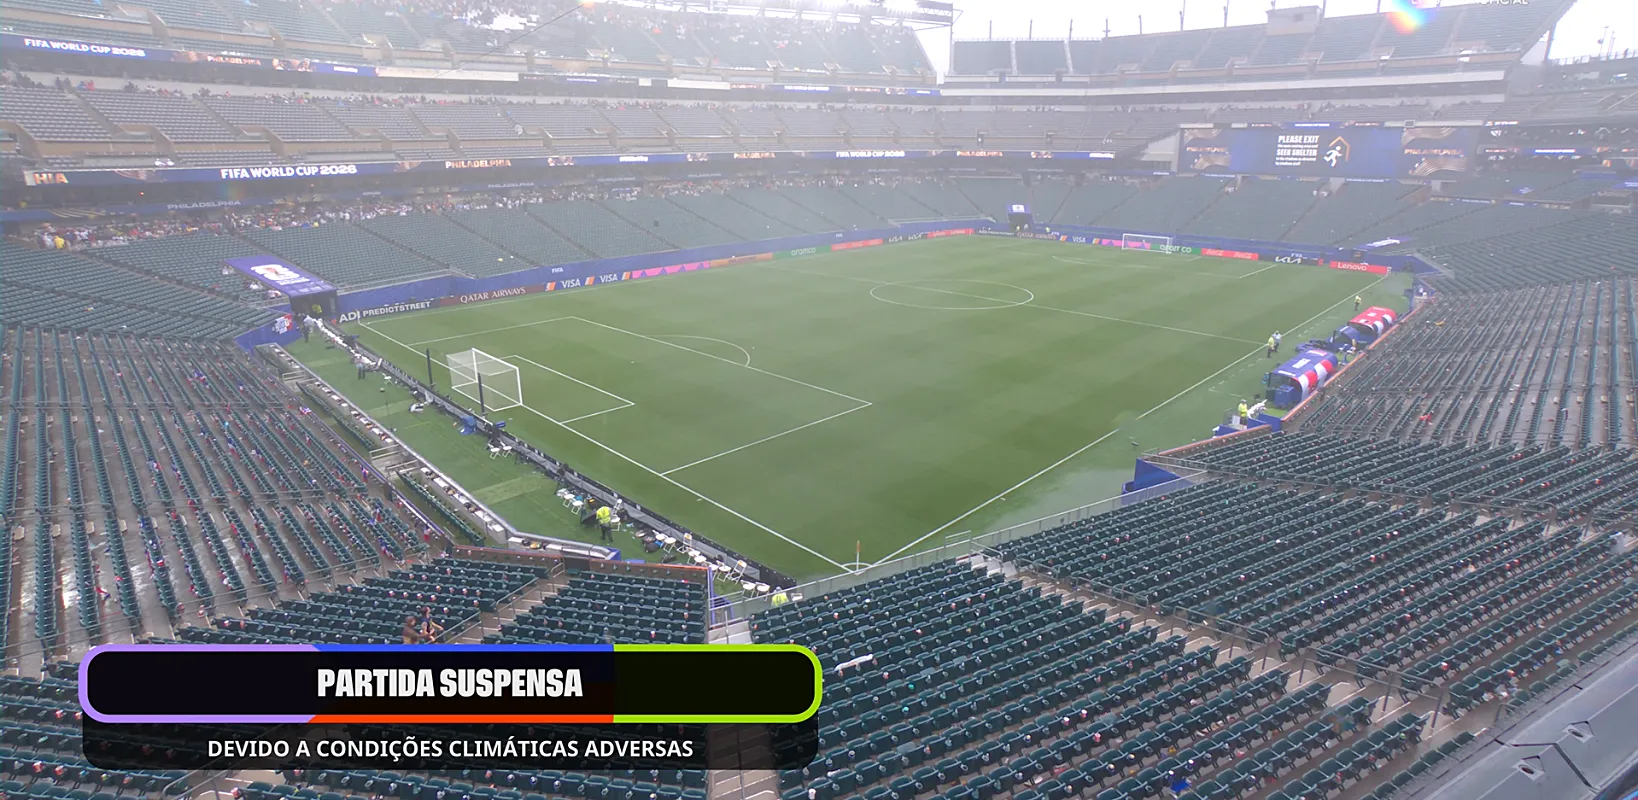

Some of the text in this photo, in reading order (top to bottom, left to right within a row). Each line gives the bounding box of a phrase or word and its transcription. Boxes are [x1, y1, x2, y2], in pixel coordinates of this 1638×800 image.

[24, 38, 146, 57] FIFA WORLD CUP 2026
[1277, 135, 1320, 143] PLEASE EXIT
[445, 159, 511, 169] PHILADELPHIA
[220, 164, 357, 179] FIFA WORLD CUP 2026
[167, 200, 241, 210] PHILADELPHIA
[790, 246, 816, 256] aramco
[1337, 261, 1368, 271] Lenovo
[599, 273, 618, 283] VISA
[560, 278, 581, 289] VISA
[460, 286, 526, 304] QATAR AIRWAYS
[362, 301, 431, 317] PREDICTSTREET
